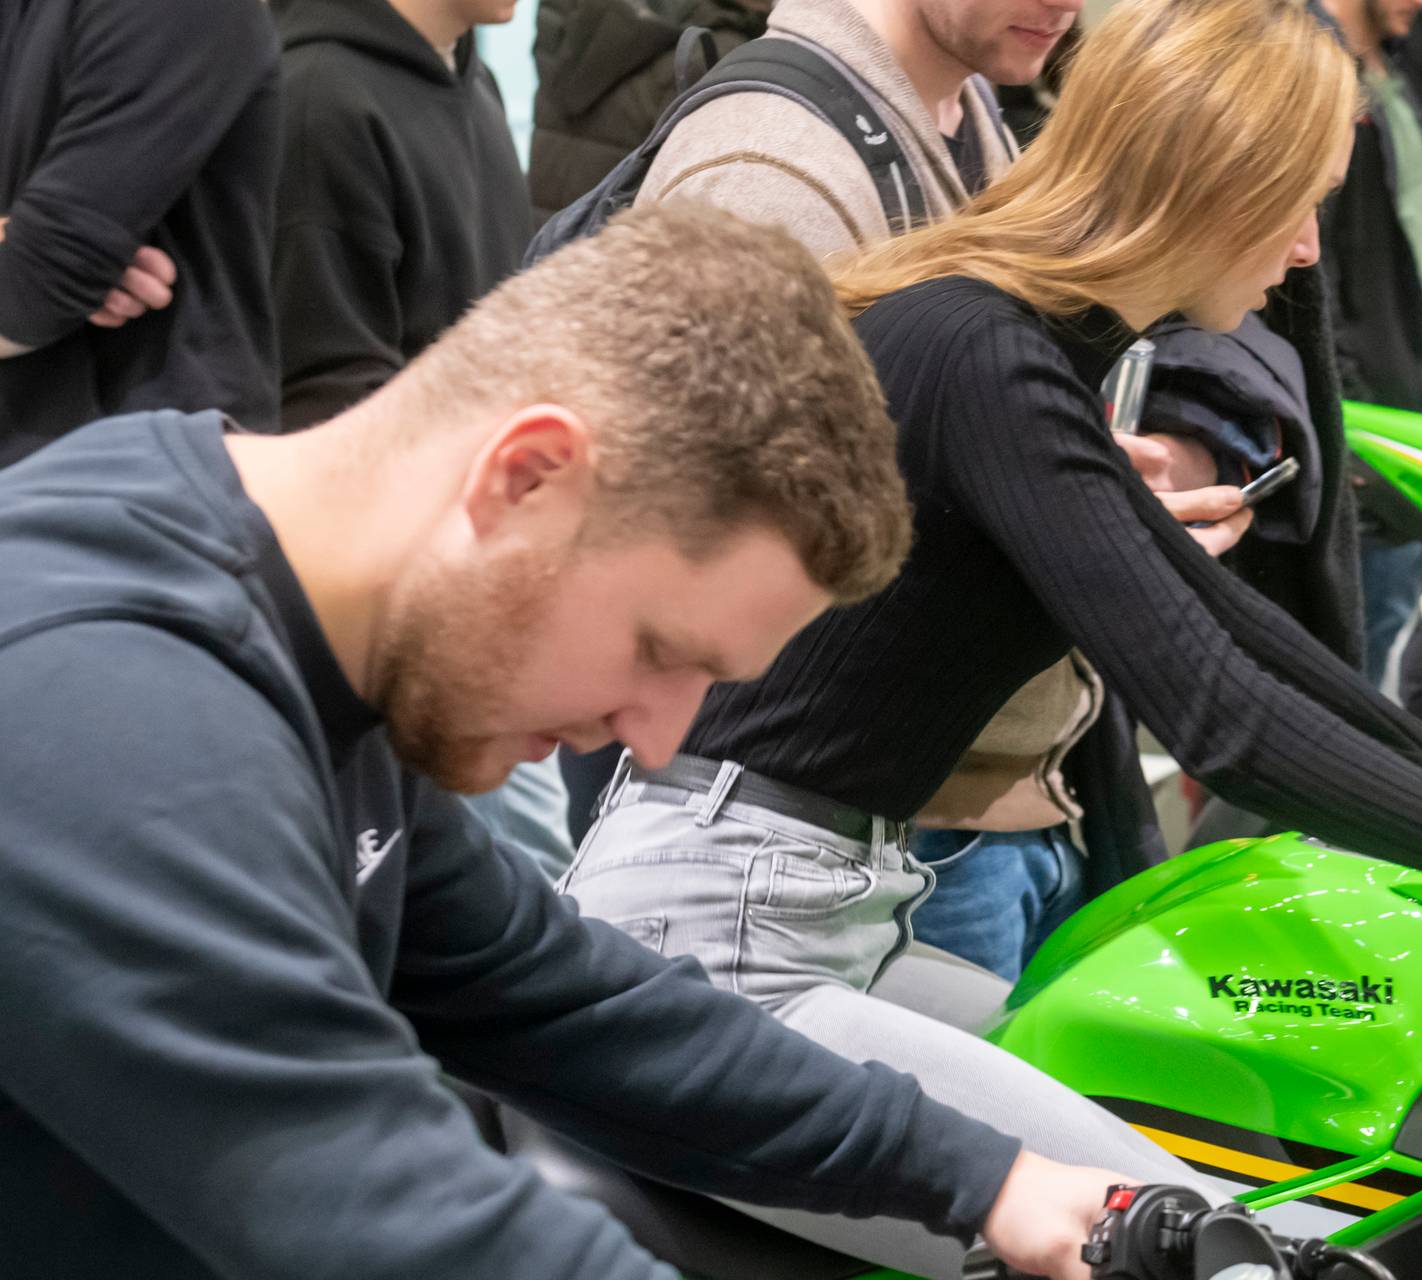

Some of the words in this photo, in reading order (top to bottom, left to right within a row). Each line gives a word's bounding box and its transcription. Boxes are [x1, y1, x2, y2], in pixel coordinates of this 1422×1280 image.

[1207, 974, 1394, 1005] Kawasaki
[1234, 1000, 1313, 1018] Racing
[1317, 1003, 1377, 1022] Team
